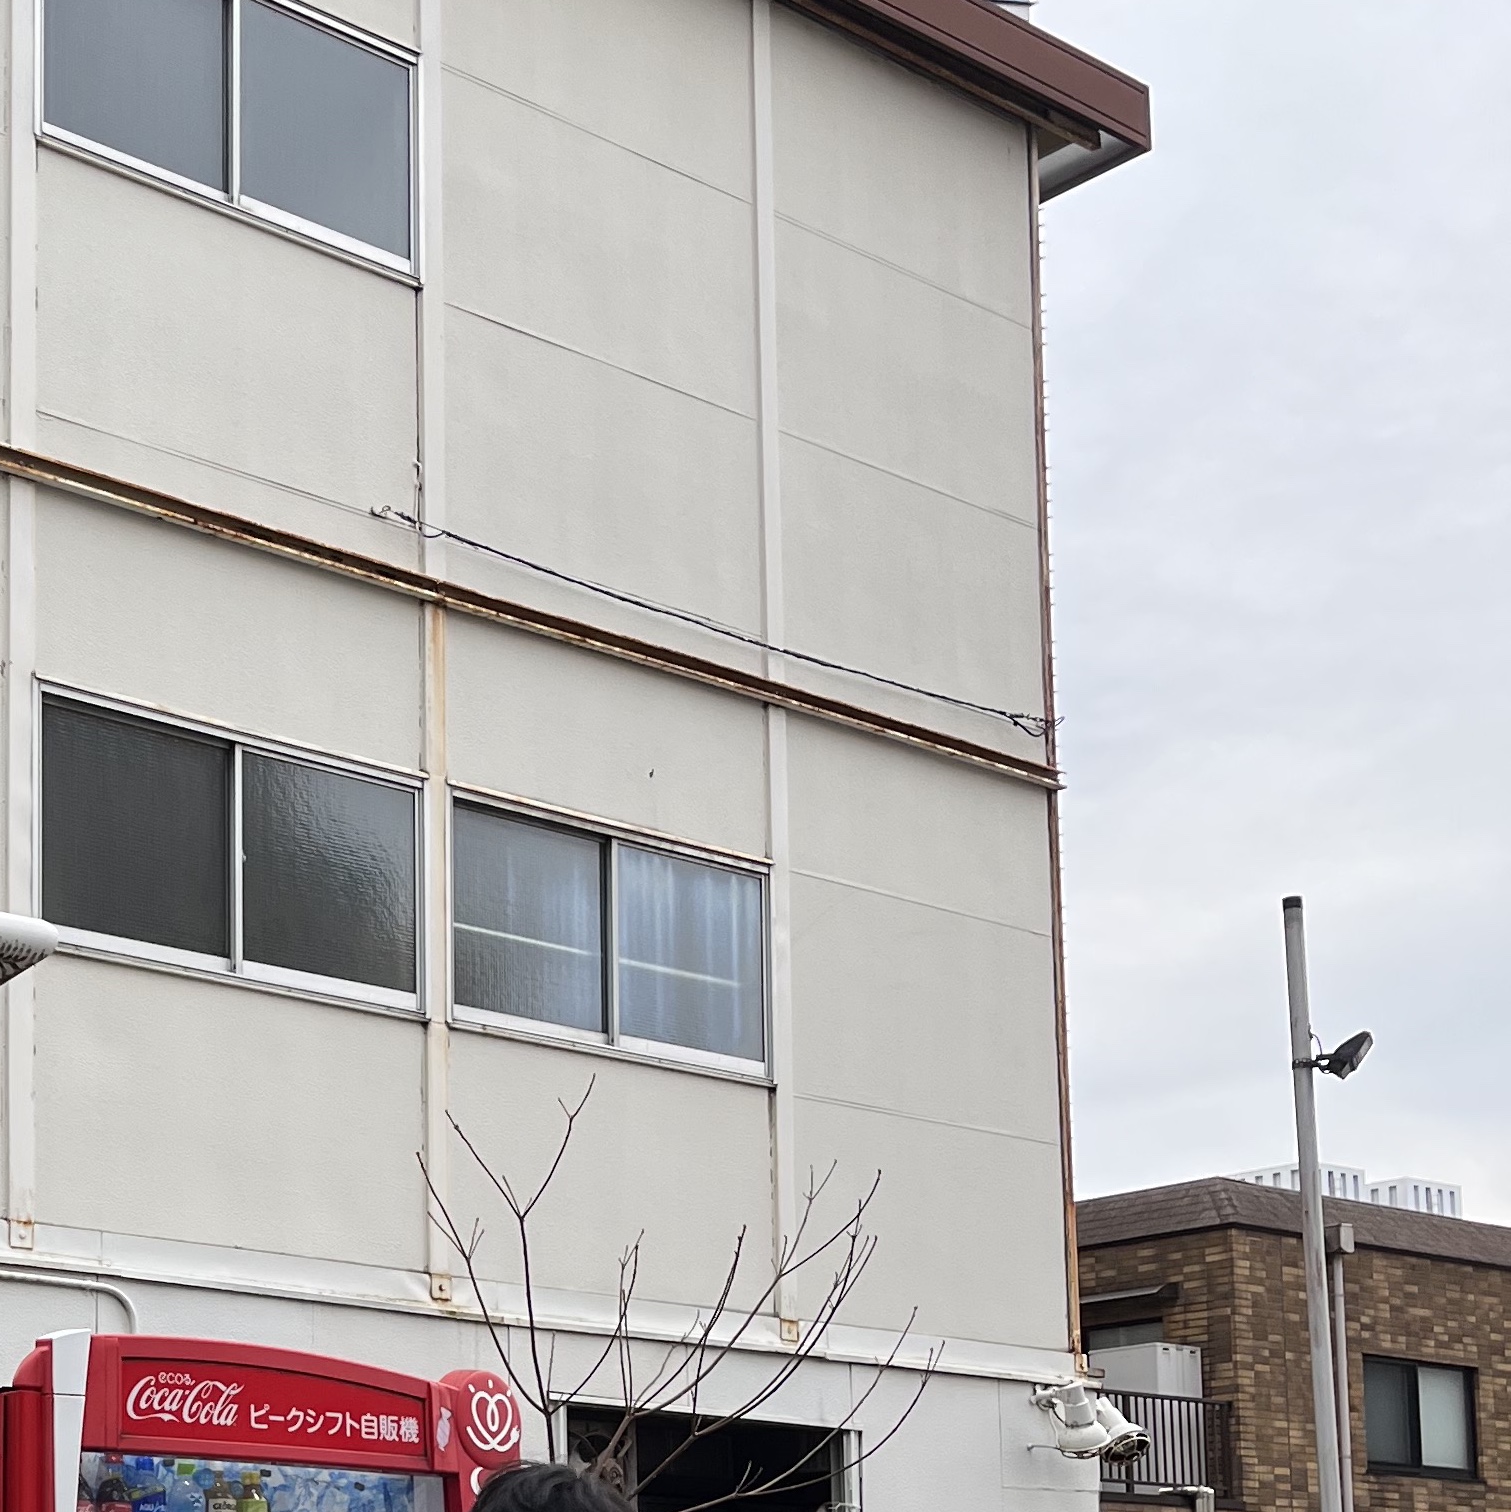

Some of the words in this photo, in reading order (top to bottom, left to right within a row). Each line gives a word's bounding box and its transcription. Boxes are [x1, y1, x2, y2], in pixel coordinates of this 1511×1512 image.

[127, 1375, 244, 1427] Coca-Cola
[250, 1403, 421, 1445] ピークシフト自販機
